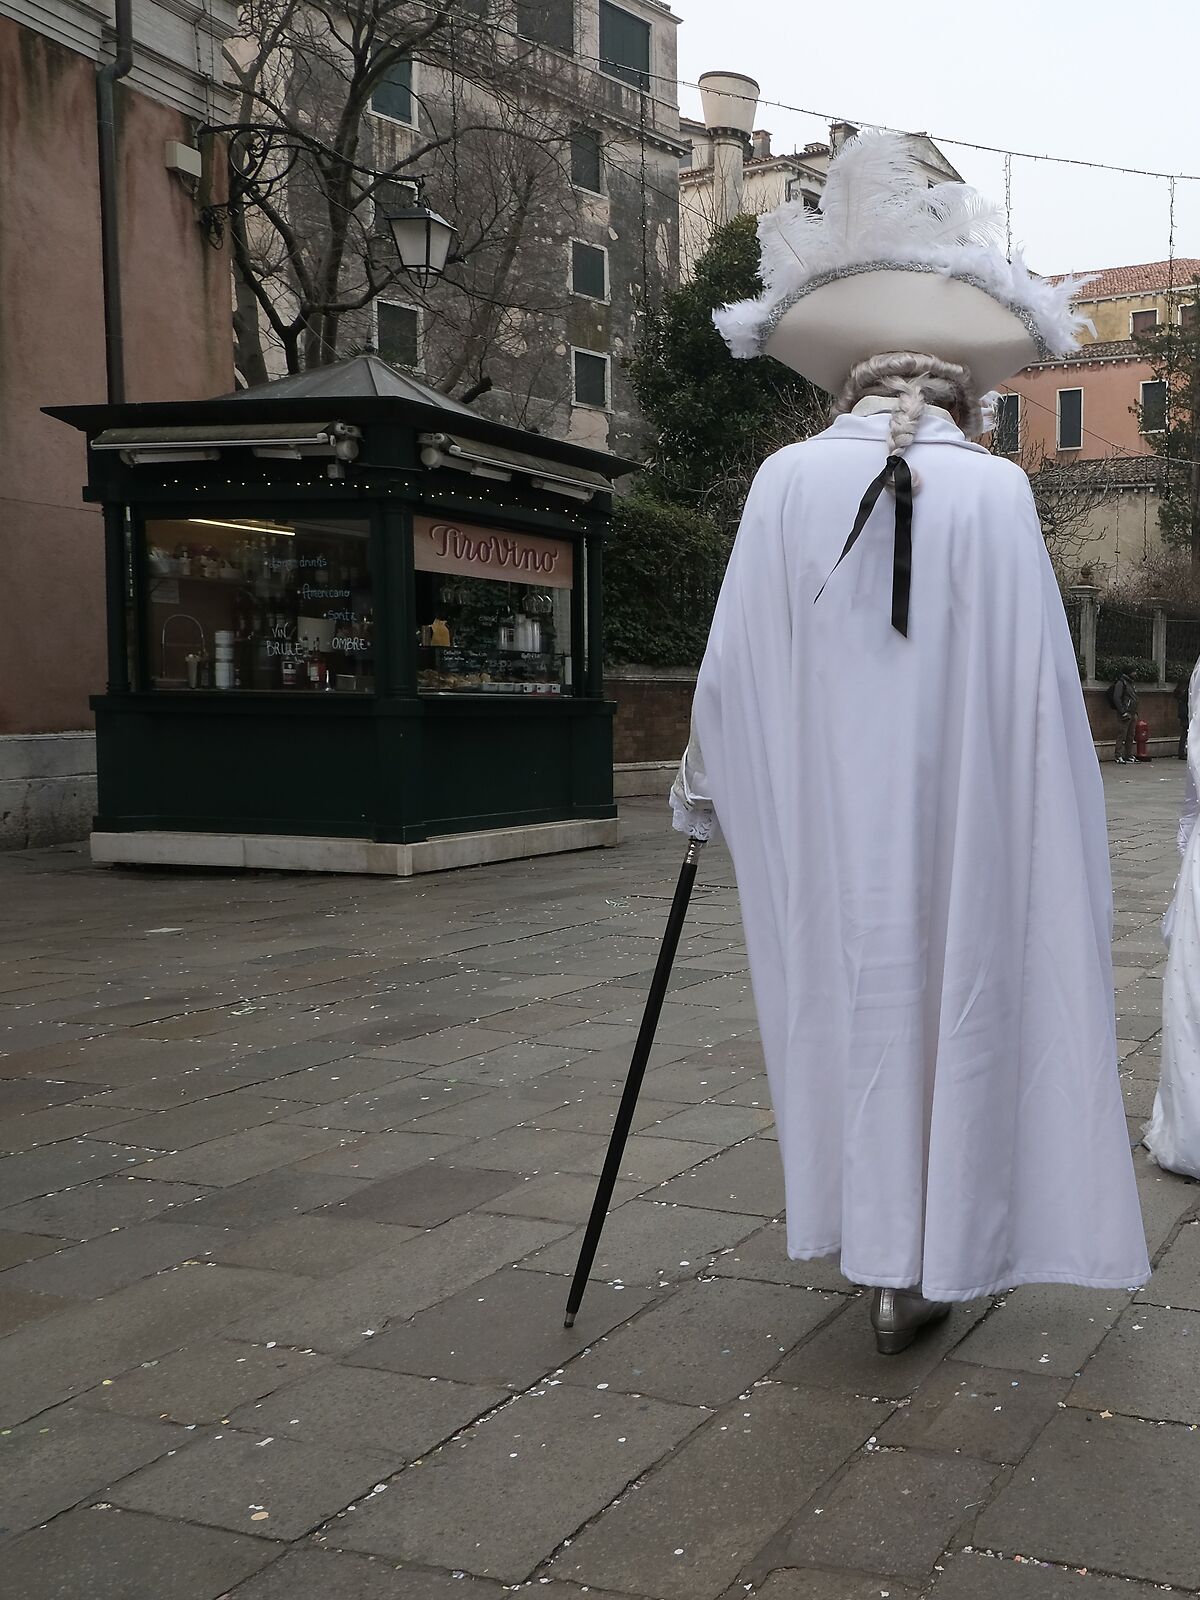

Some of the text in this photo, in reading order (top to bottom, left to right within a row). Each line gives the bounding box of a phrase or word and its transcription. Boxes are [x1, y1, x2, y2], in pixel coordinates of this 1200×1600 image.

[303, 583, 351, 599] Americano
[271, 622, 288, 638] VIN
[332, 636, 368, 651] OMBRE
